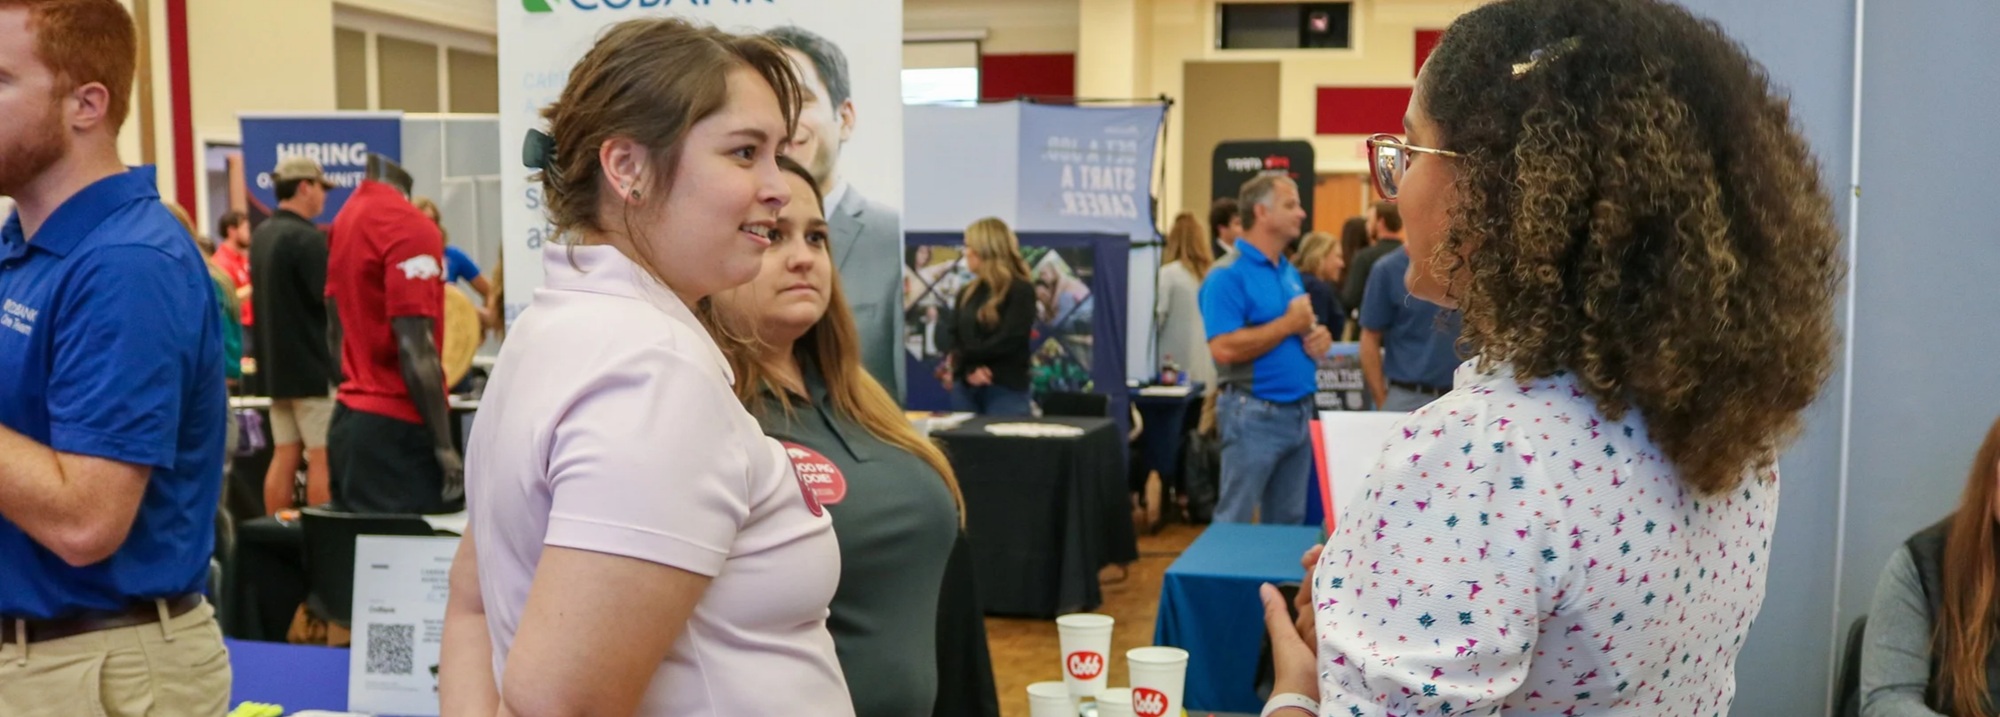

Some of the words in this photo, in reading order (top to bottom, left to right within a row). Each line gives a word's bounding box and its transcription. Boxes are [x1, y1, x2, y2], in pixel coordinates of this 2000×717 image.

[276, 142, 367, 167] HIRING
[1069, 654, 1101, 676] Cobb
[1134, 690, 1164, 715] Cobb
